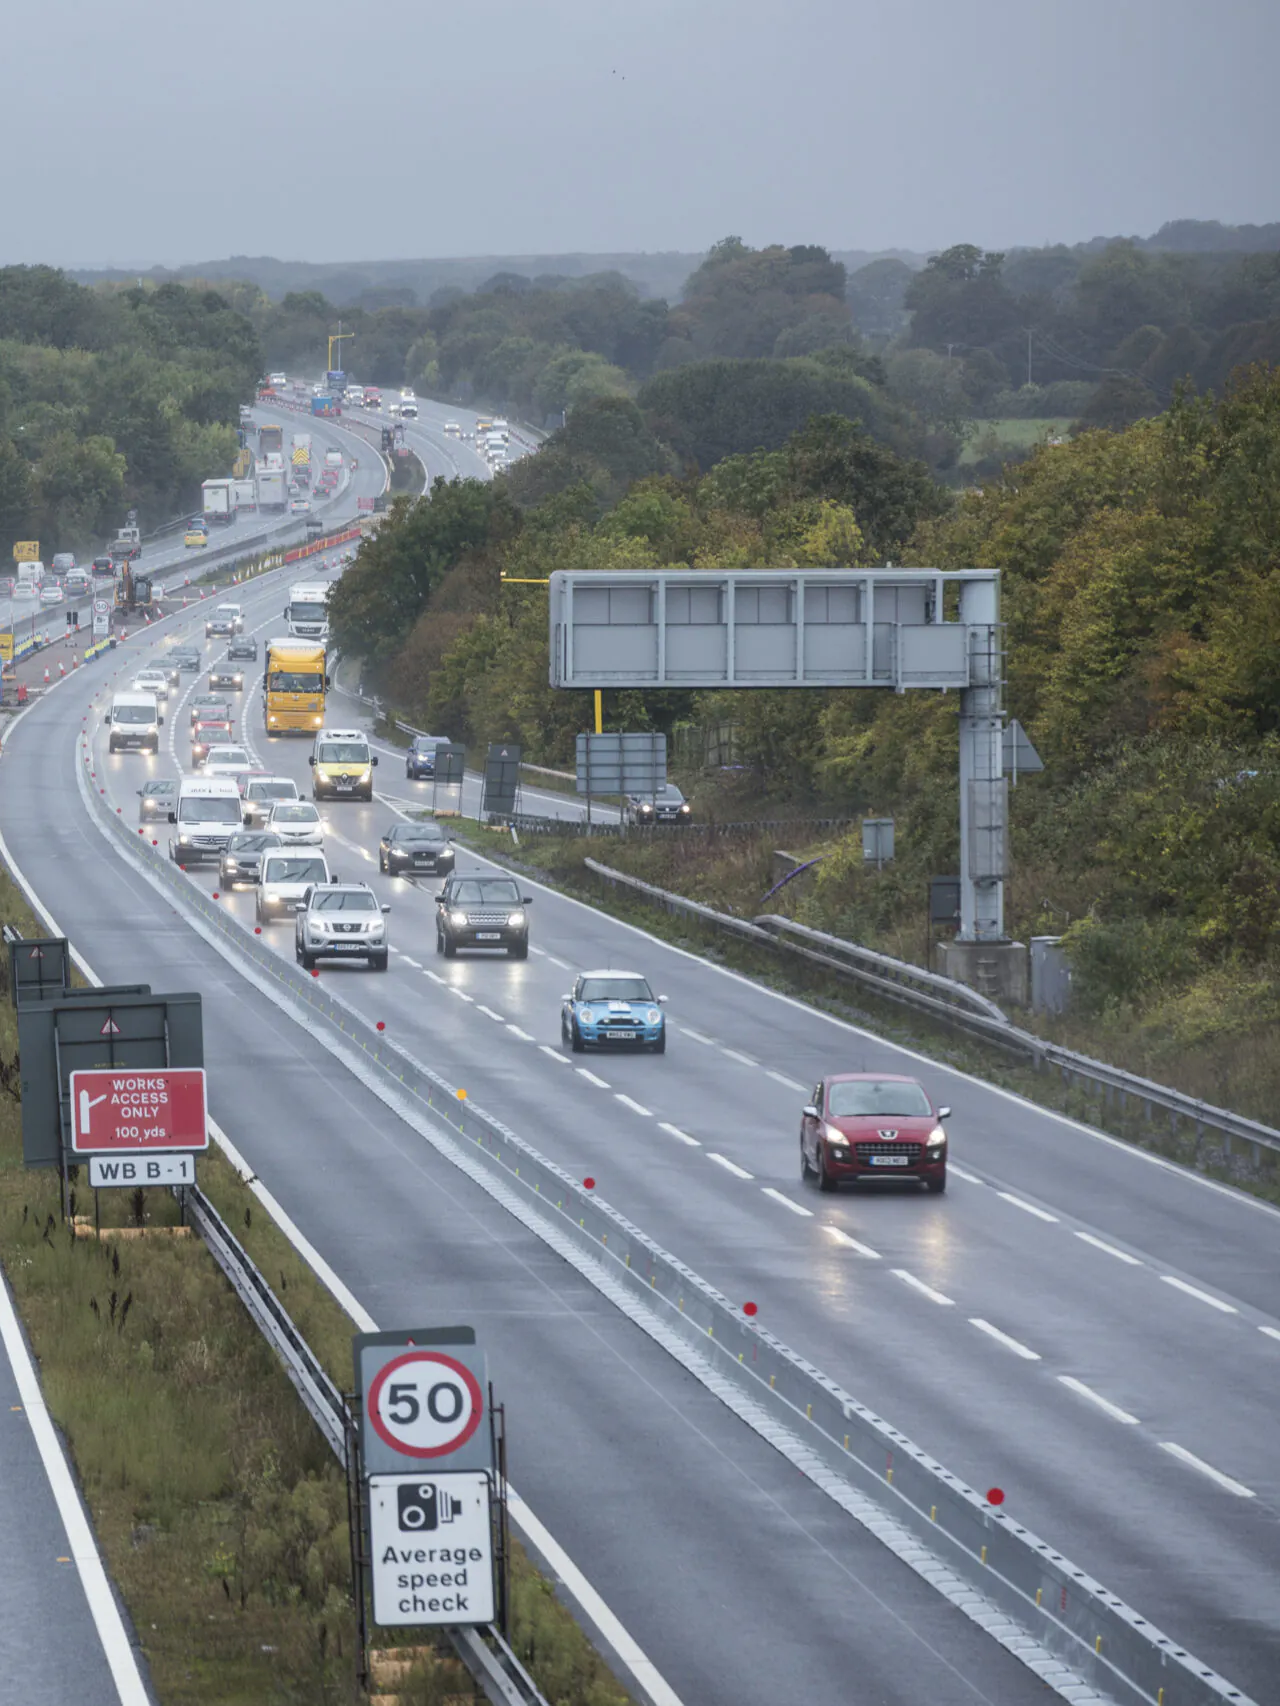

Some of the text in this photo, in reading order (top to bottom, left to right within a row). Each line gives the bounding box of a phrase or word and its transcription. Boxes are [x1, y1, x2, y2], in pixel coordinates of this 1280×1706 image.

[112, 1078, 166, 1091] WORKS
[111, 1092, 169, 1105] ACCESS
[121, 1106, 159, 1118] ONLY
[115, 1125, 166, 1140] 100 yds
[99, 1162, 137, 1180] WB
[387, 1381, 464, 1425] 50
[381, 1546, 483, 1566] Average
[397, 1568, 468, 1591] speed
[398, 1592, 469, 1613] check
